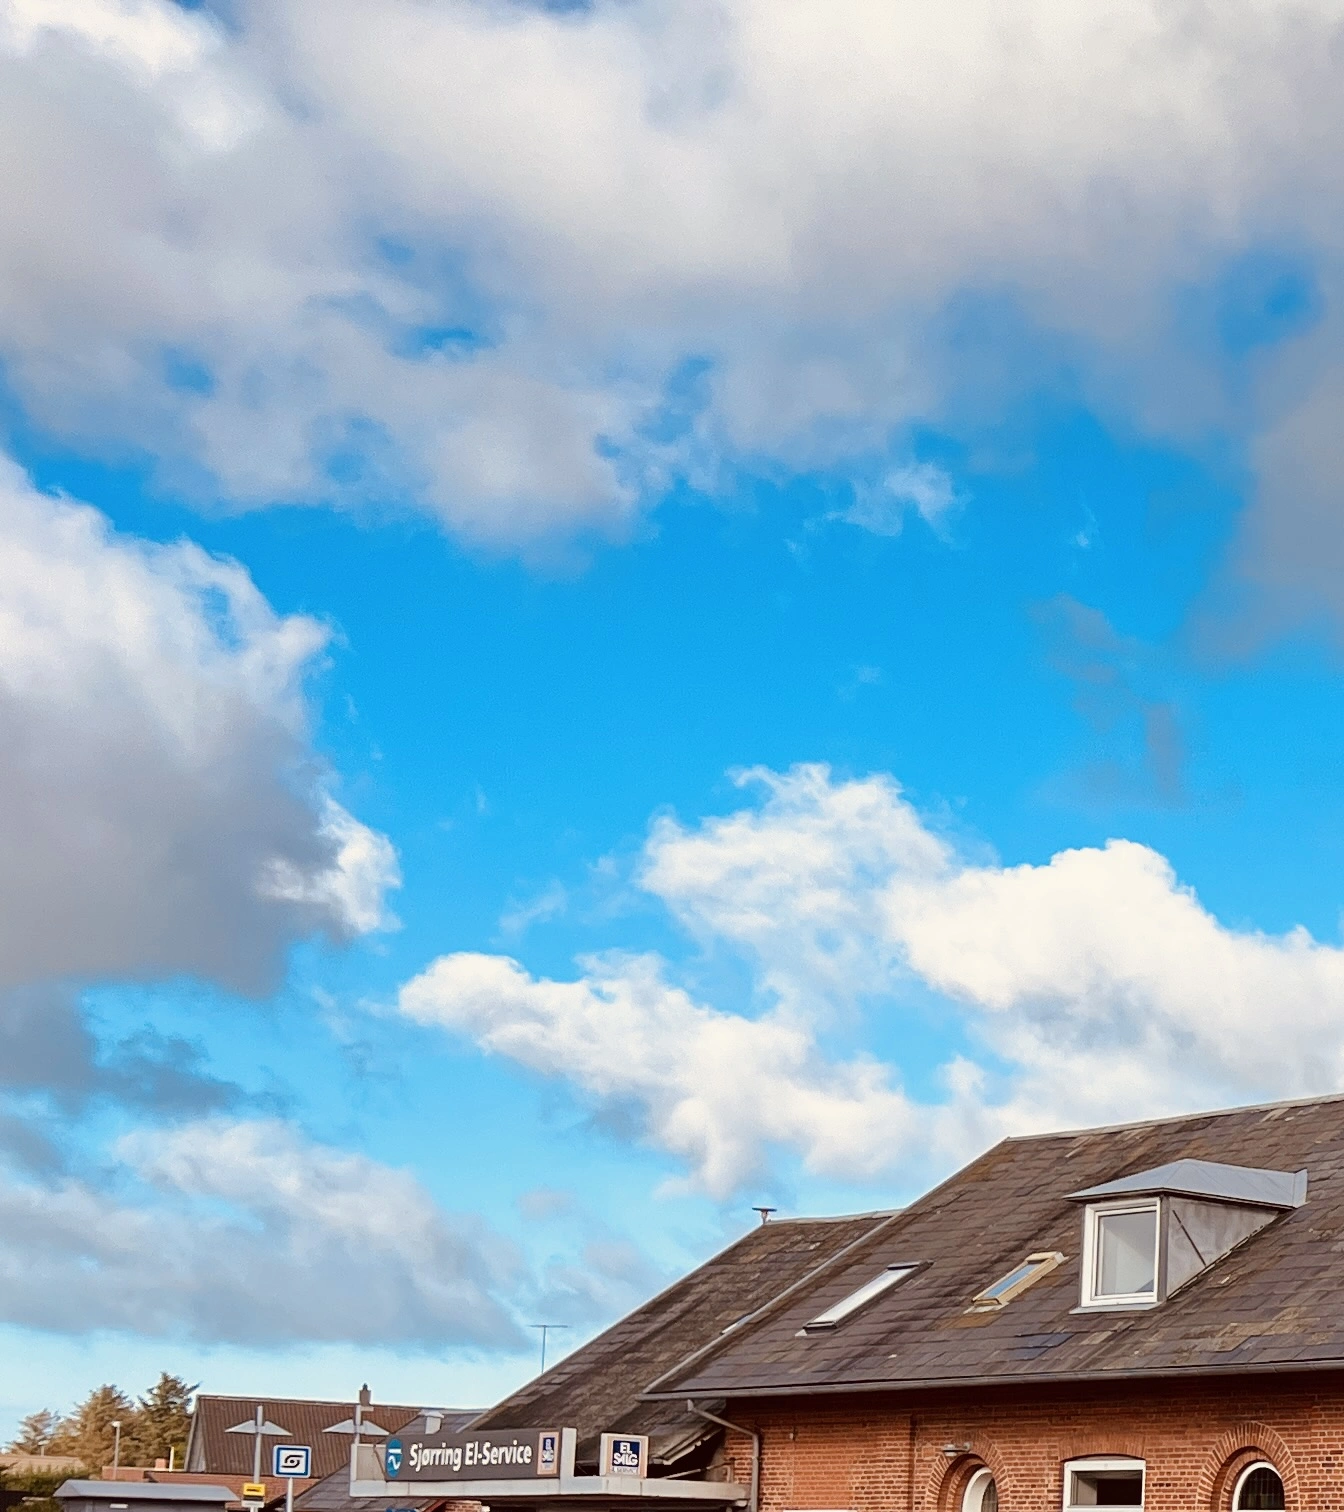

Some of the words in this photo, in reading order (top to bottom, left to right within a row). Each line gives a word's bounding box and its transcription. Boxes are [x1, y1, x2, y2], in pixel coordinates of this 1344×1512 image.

[619, 1441, 633, 1454] EL
[409, 1443, 463, 1472] Sjørring
[464, 1439, 532, 1467] El-Service
[613, 1452, 638, 1466] SALG
